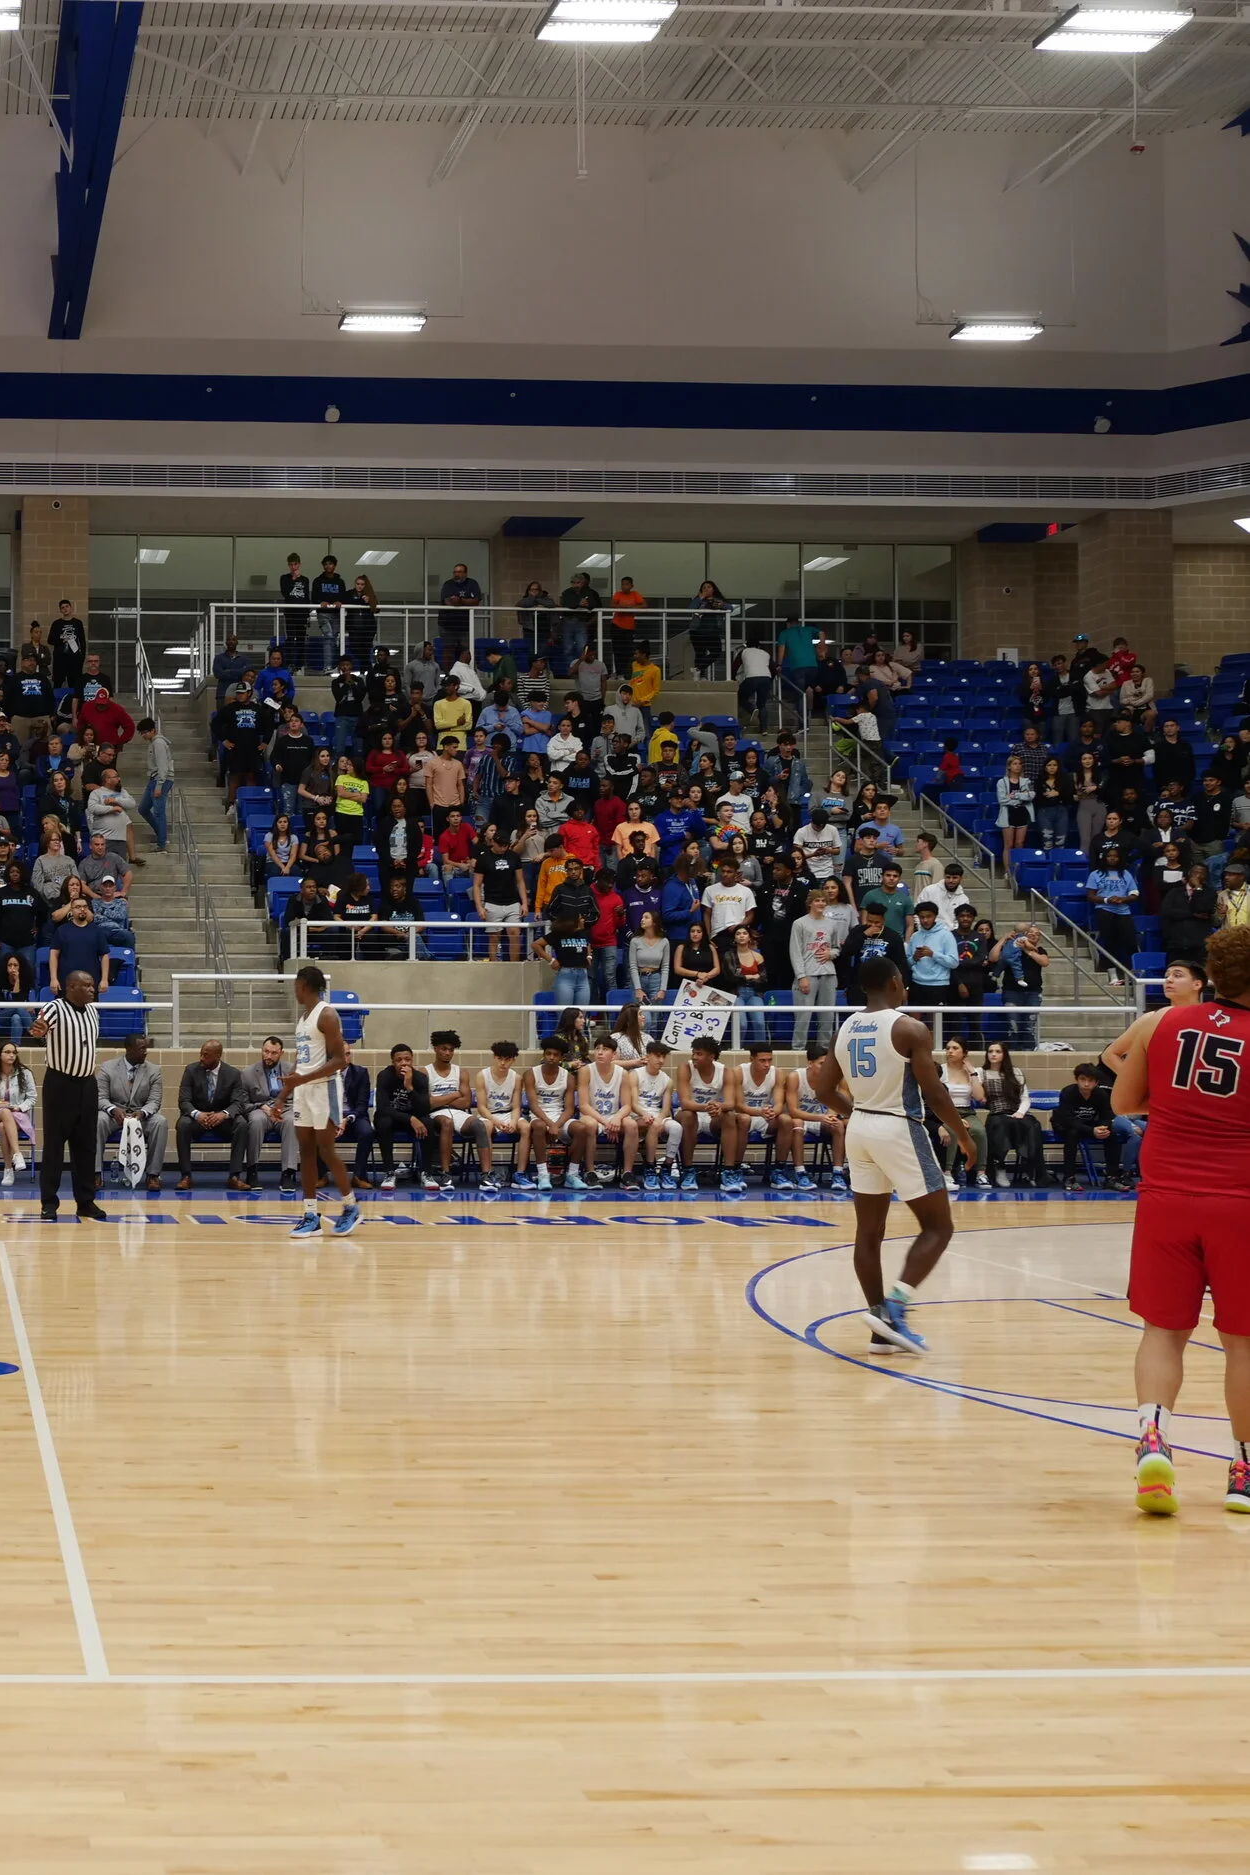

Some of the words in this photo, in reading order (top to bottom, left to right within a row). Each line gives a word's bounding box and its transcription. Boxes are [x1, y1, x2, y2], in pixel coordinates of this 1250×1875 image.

[857, 867, 883, 884] SPURS
[847, 1037, 877, 1078] 15
[1172, 1028, 1245, 1098] 15
